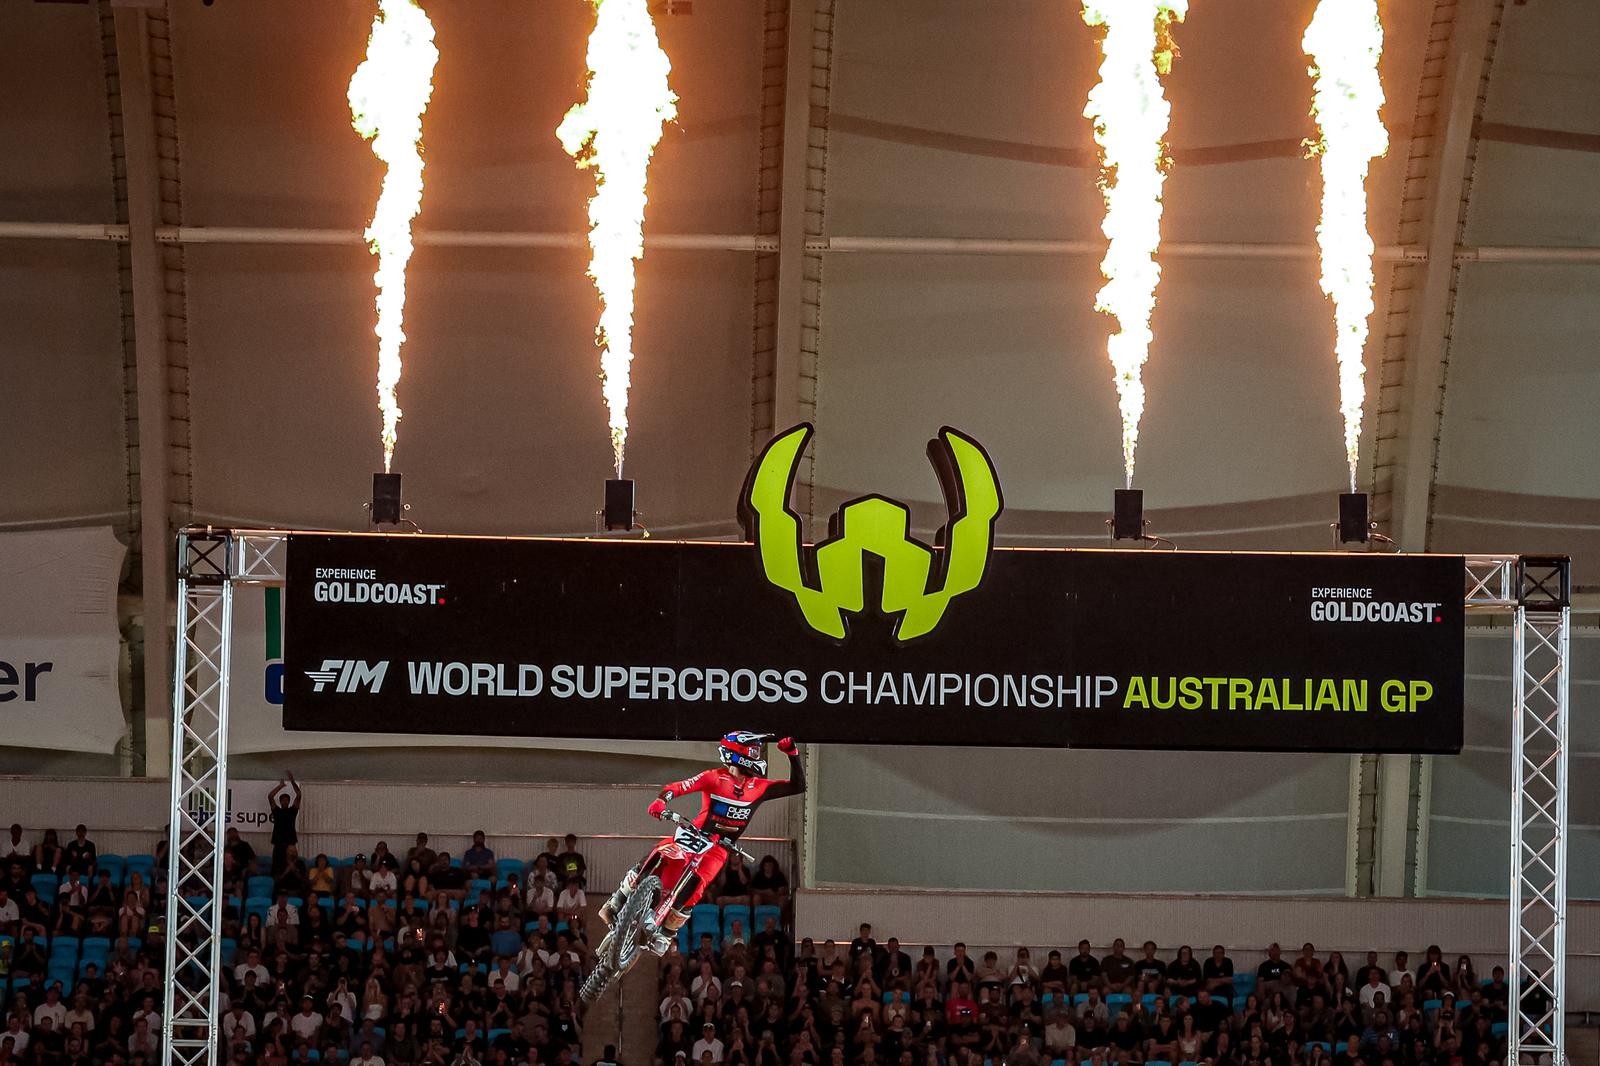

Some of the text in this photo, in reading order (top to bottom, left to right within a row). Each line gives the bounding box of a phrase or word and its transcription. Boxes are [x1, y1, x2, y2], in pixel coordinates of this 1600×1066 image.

[315, 568, 377, 580] EXPERIENCE
[1311, 587, 1373, 600] EXPERIENCE
[304, 659, 390, 694] FIM
[407, 661, 544, 697] WORLD
[550, 664, 808, 704] SUPERCROSS
[820, 670, 1118, 708] CHAMPIONSHIP
[1123, 676, 1368, 712] AUSTRALIAN
[1380, 679, 1434, 713] GP
[726, 811, 748, 820] LOCK
[675, 832, 708, 853] 28
